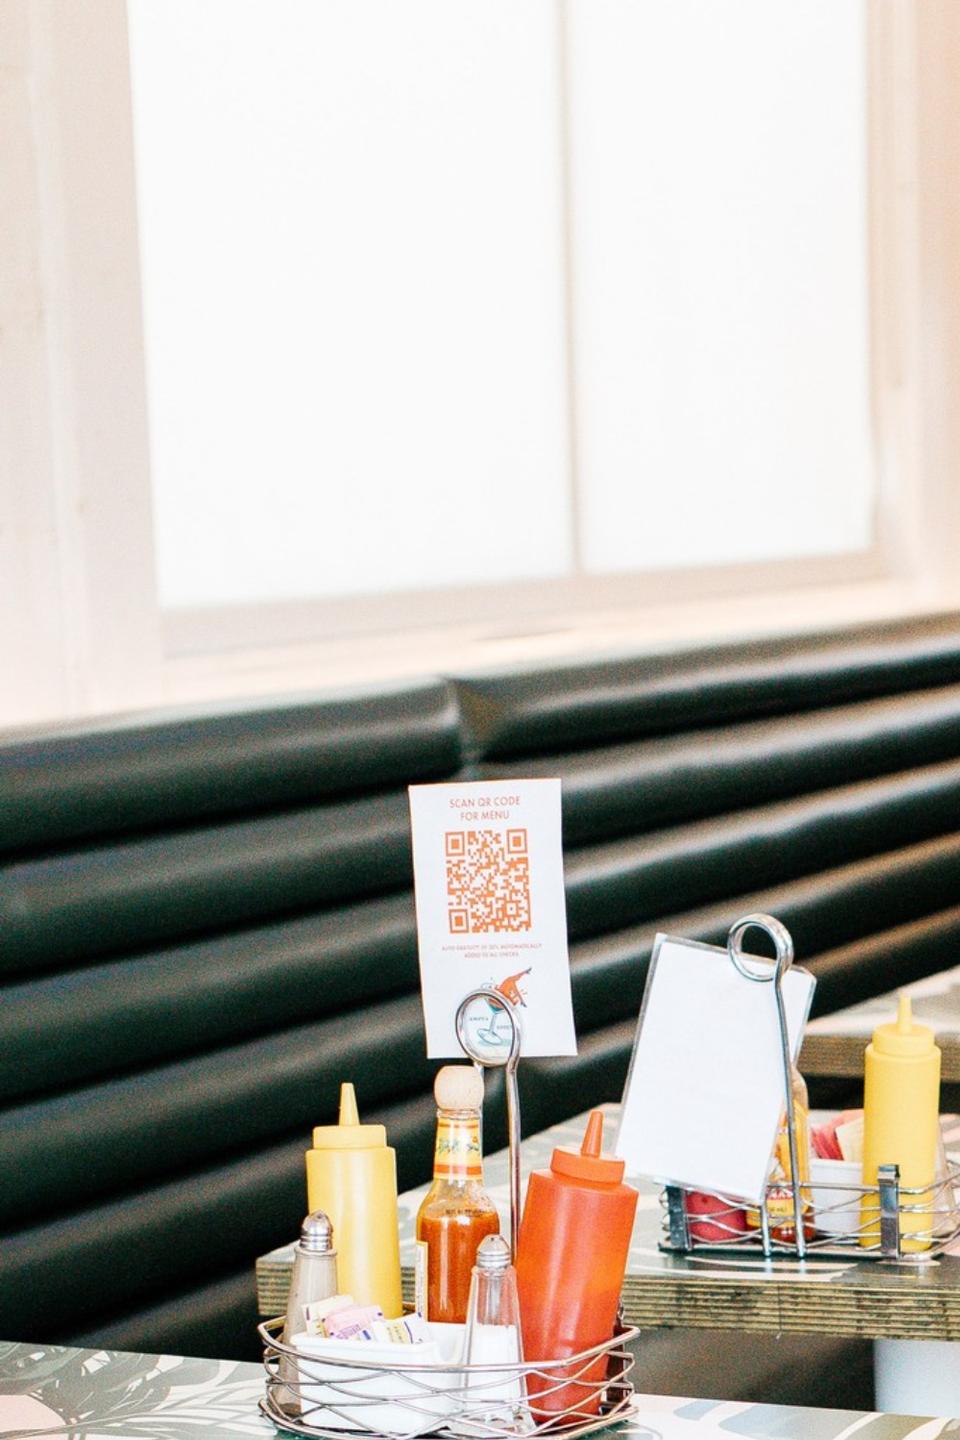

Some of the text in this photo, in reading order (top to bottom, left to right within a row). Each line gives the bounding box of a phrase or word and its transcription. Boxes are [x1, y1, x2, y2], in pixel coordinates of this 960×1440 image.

[448, 795, 520, 808] SCAN QR CODE
[460, 810, 510, 821] FOR MENU
